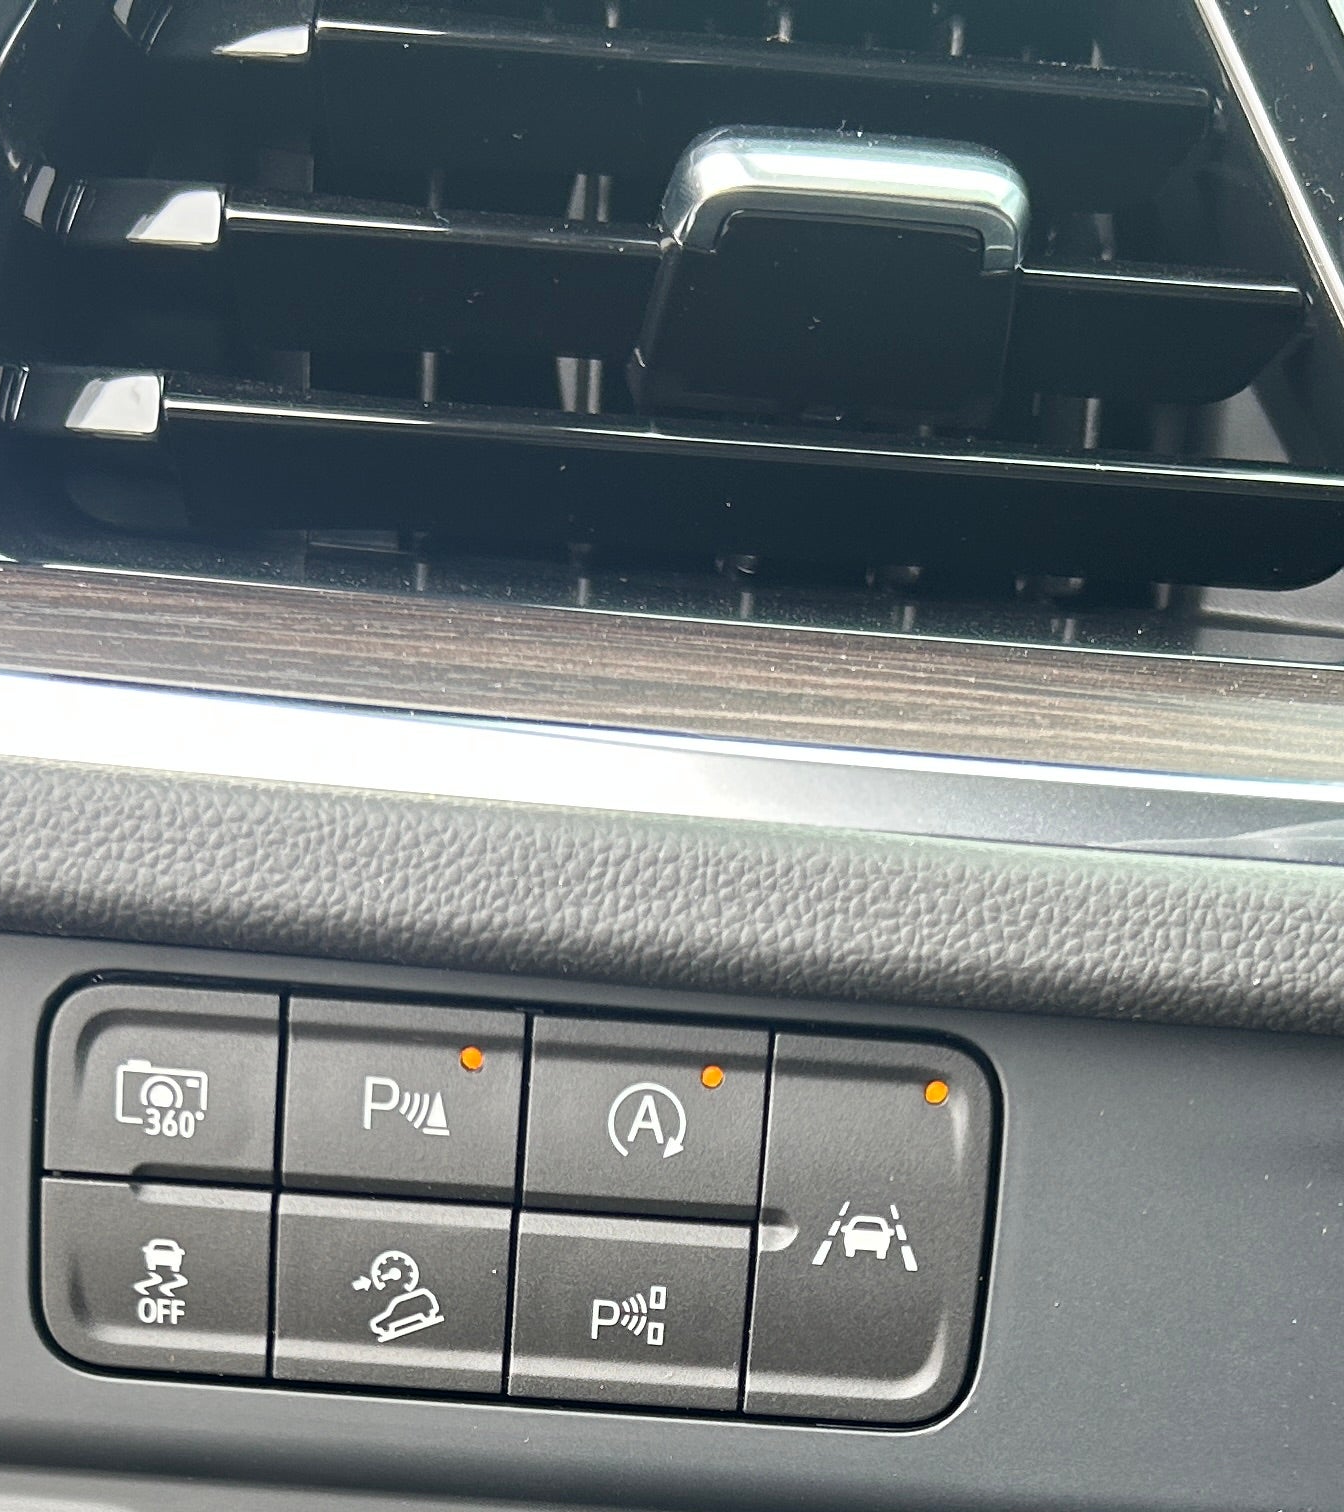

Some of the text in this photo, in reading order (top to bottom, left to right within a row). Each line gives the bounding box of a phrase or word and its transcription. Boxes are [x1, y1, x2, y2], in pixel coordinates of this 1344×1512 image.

[364, 1077, 399, 1130] P
[627, 1095, 665, 1146] A
[138, 1298, 185, 1325] OFF
[592, 1300, 620, 1340] P
